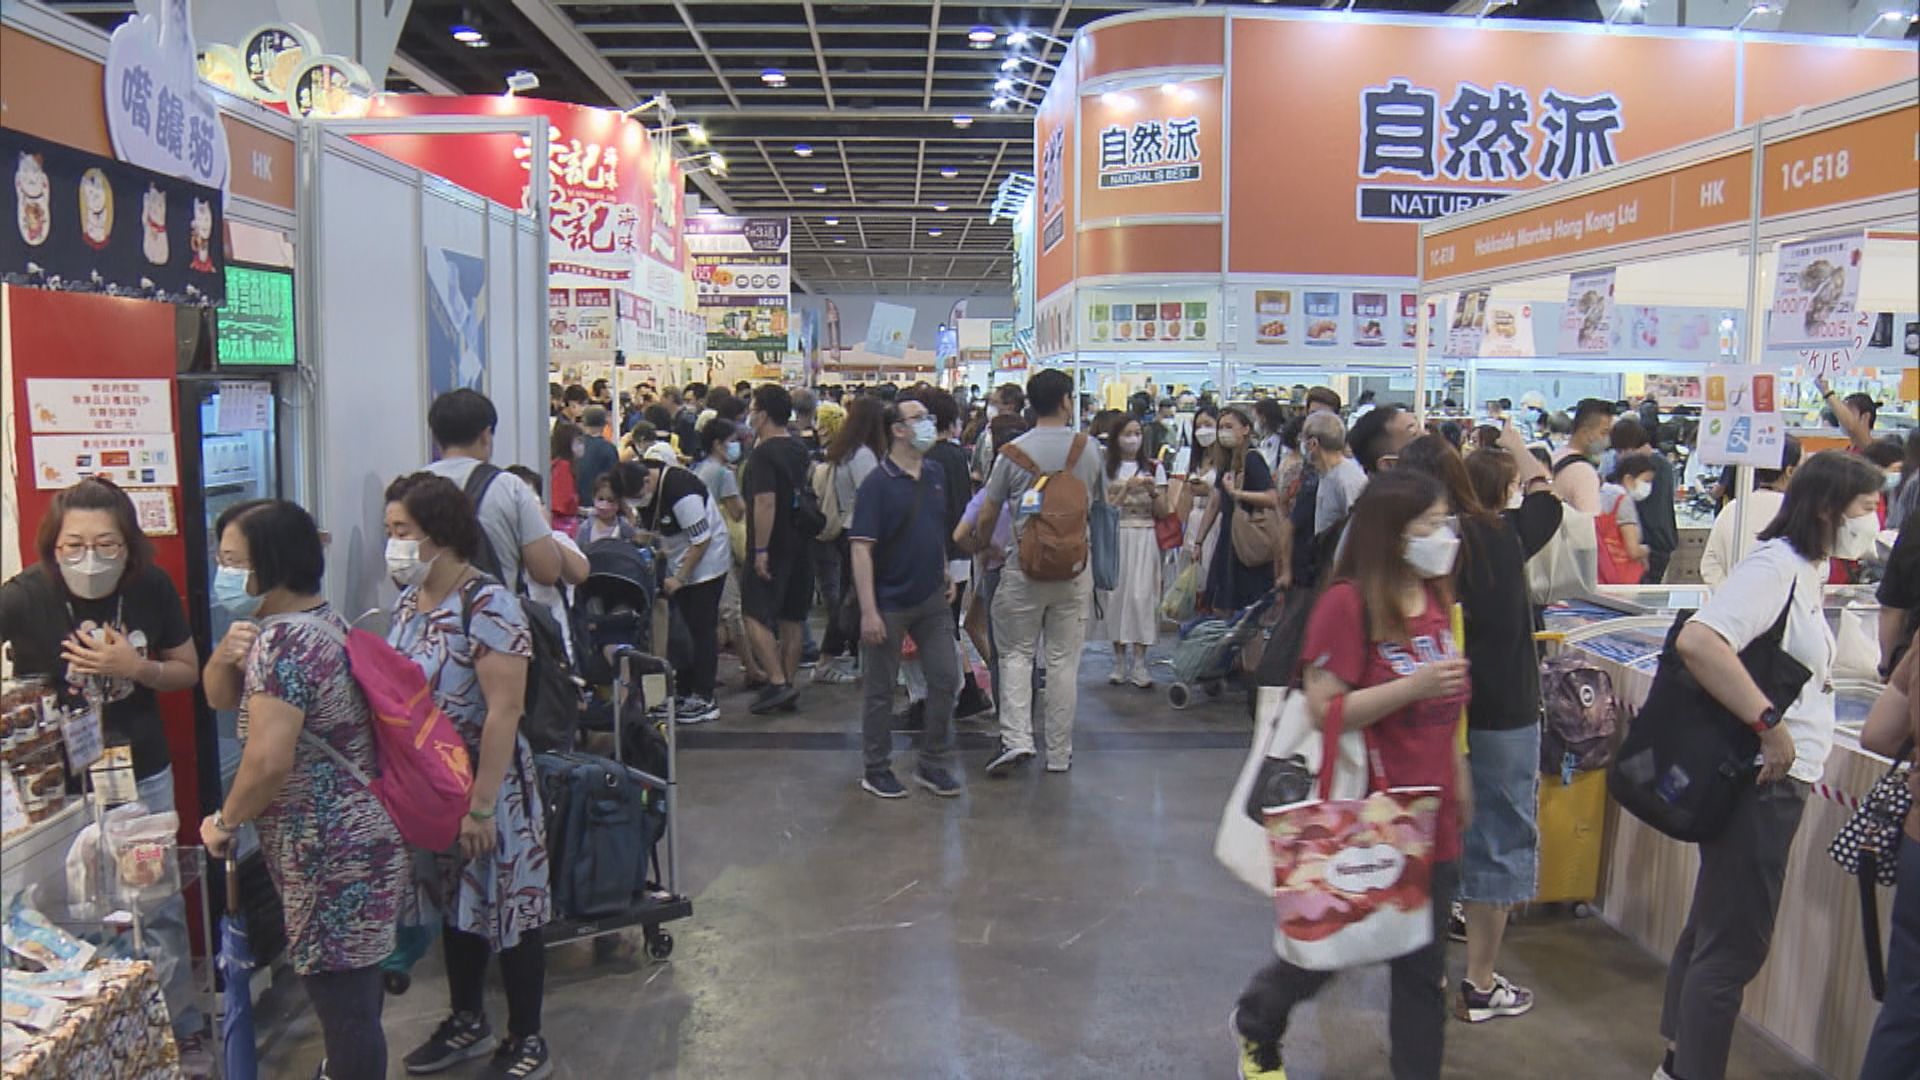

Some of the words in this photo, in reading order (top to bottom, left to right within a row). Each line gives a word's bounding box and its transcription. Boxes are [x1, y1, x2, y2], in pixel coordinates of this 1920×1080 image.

[1100, 117, 1200, 168] 自然派
[1359, 76, 1622, 179] 自然派
[251, 150, 273, 181] HK
[1110, 170, 1153, 186] NATURAL
[1155, 170, 1164, 181] IS
[1166, 167, 1191, 181] BEST
[1781, 149, 1849, 192] 1C-E18
[1700, 179, 1725, 208] HK
[1430, 246, 1455, 266] 1C-E18
[1475, 236, 1514, 256] Hokkaido
[1517, 226, 1552, 247] Marche
[1555, 219, 1583, 240] Hong
[1585, 210, 1615, 232] Kong
[1619, 203, 1637, 224] Ltd
